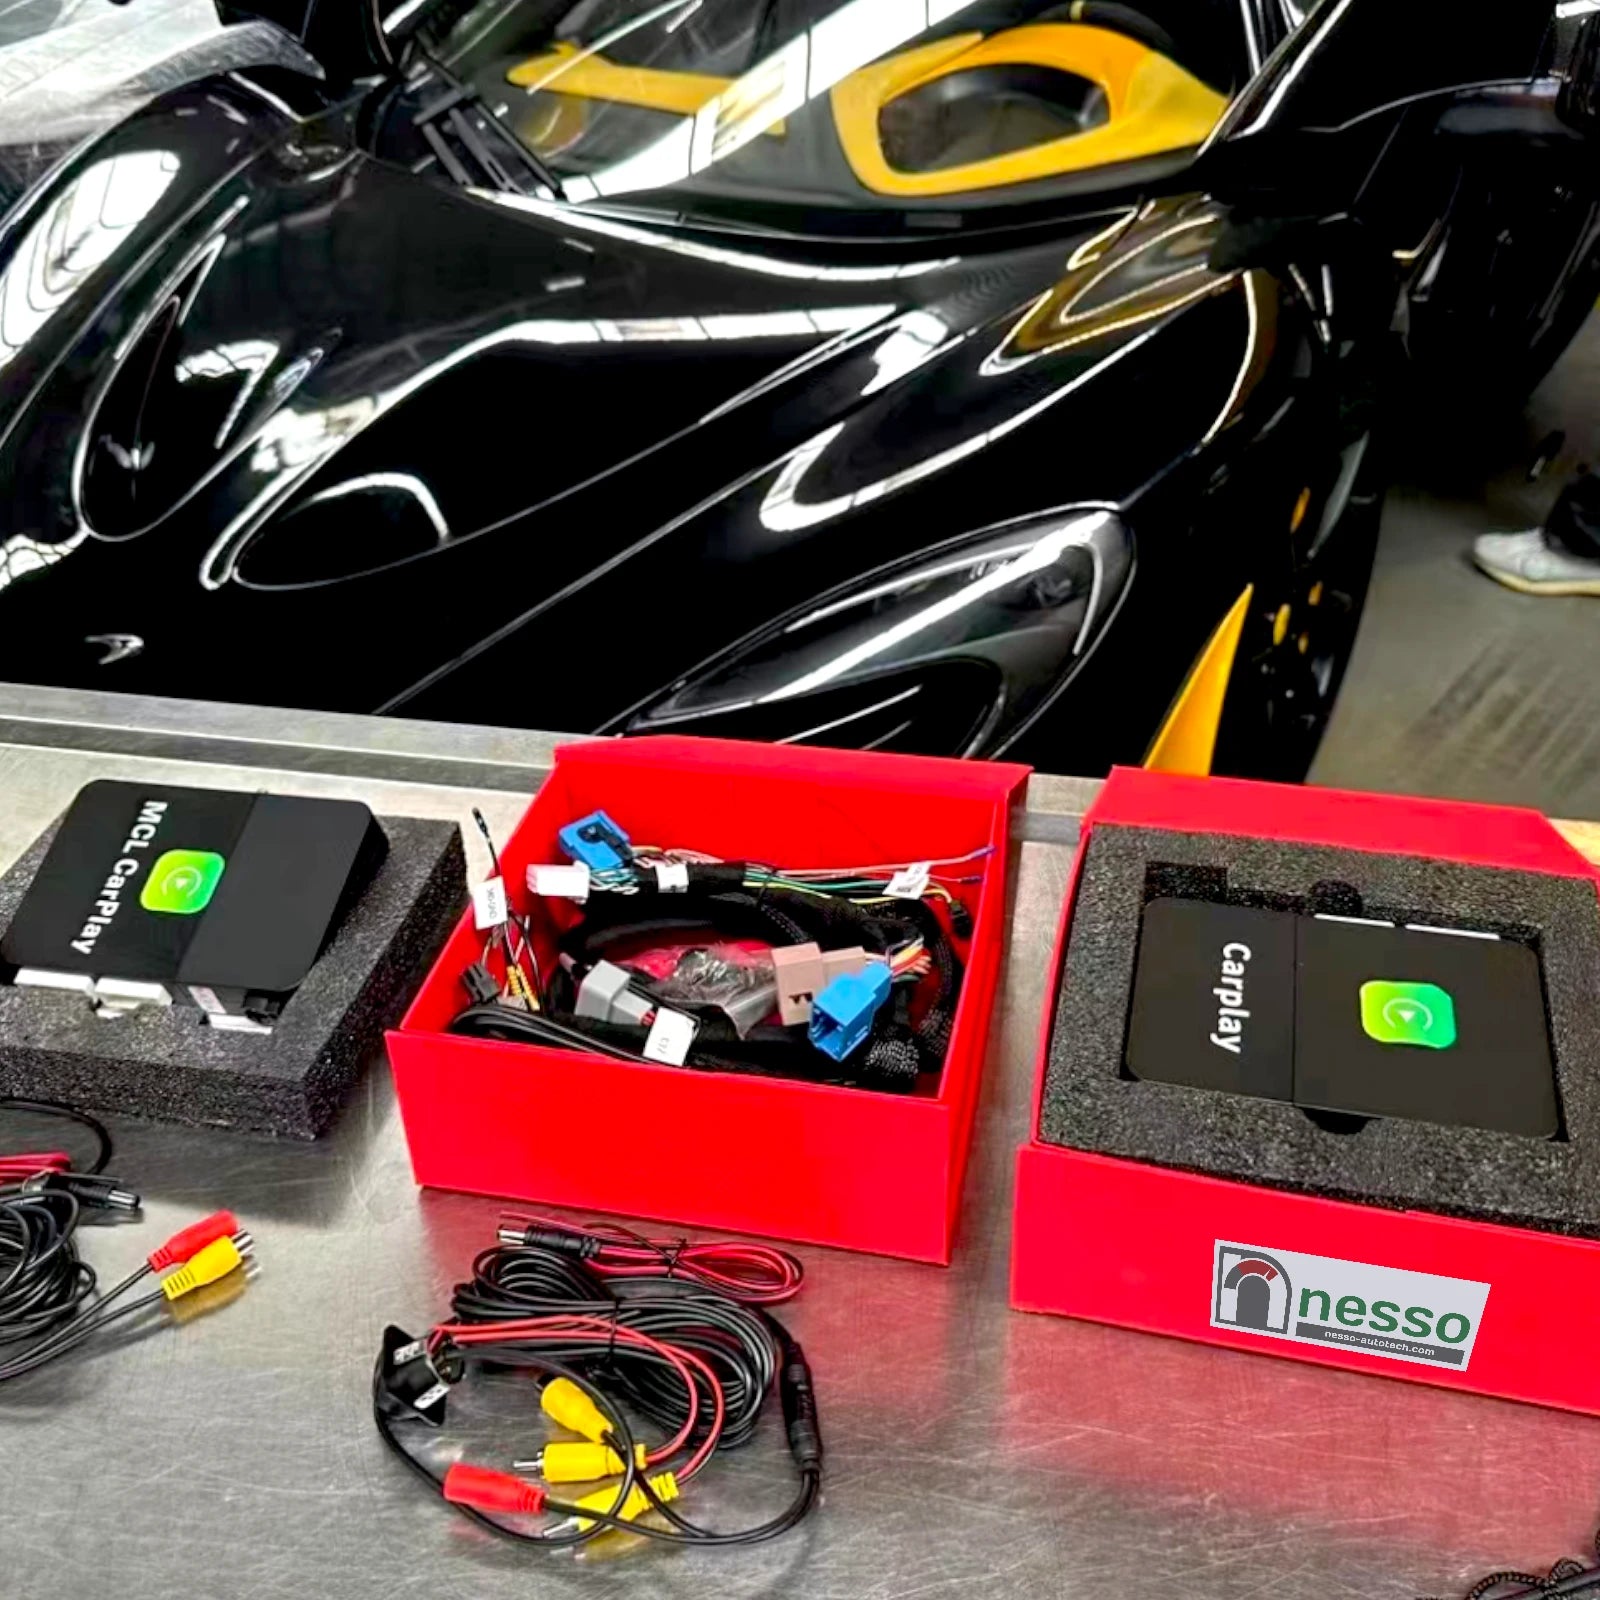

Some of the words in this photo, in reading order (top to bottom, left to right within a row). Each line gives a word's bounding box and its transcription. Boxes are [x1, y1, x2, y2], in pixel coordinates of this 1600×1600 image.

[122, 800, 168, 854] MCL
[71, 858, 139, 954] CarPlay
[1210, 942, 1251, 1053] Carplay
[1299, 1287, 1471, 1344] nesso
[1324, 1330, 1435, 1356] nesso-autotech.com
